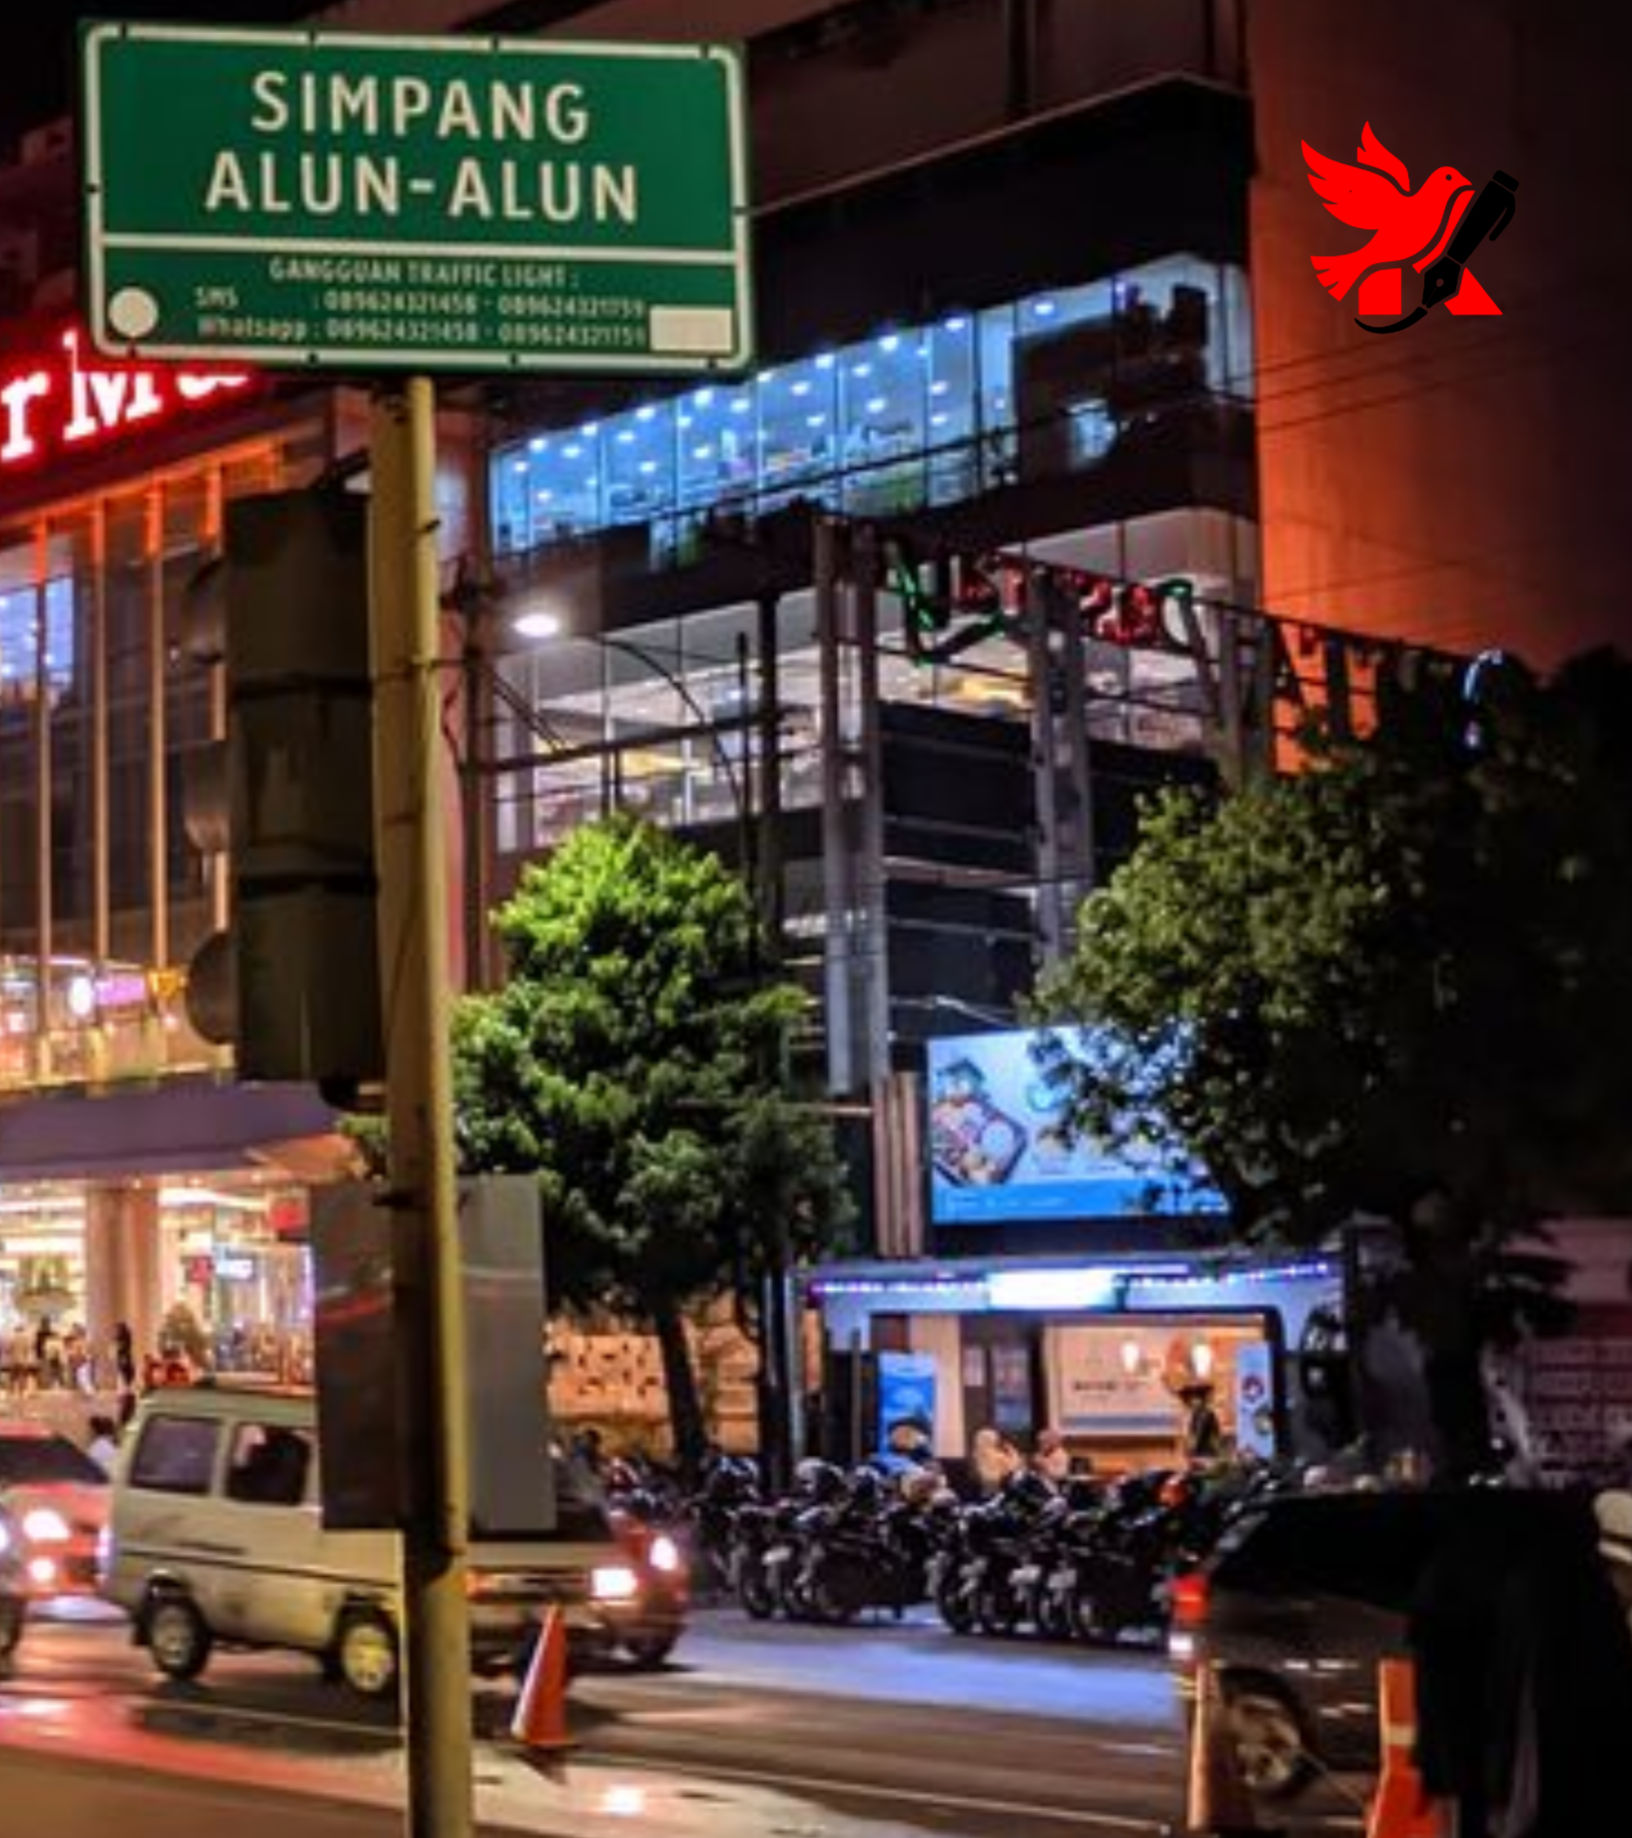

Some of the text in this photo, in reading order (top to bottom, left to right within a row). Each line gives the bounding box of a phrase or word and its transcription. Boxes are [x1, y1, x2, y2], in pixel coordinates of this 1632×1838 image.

[251, 70, 589, 142] SIMPANG
[205, 151, 638, 223] ALUN-ALUN
[268, 257, 401, 283] GANGGUAN
[407, 261, 499, 287] TRAFFIC
[502, 263, 566, 288] LIGHT
[195, 285, 239, 309] SMS
[197, 315, 308, 342] Whatsapp
